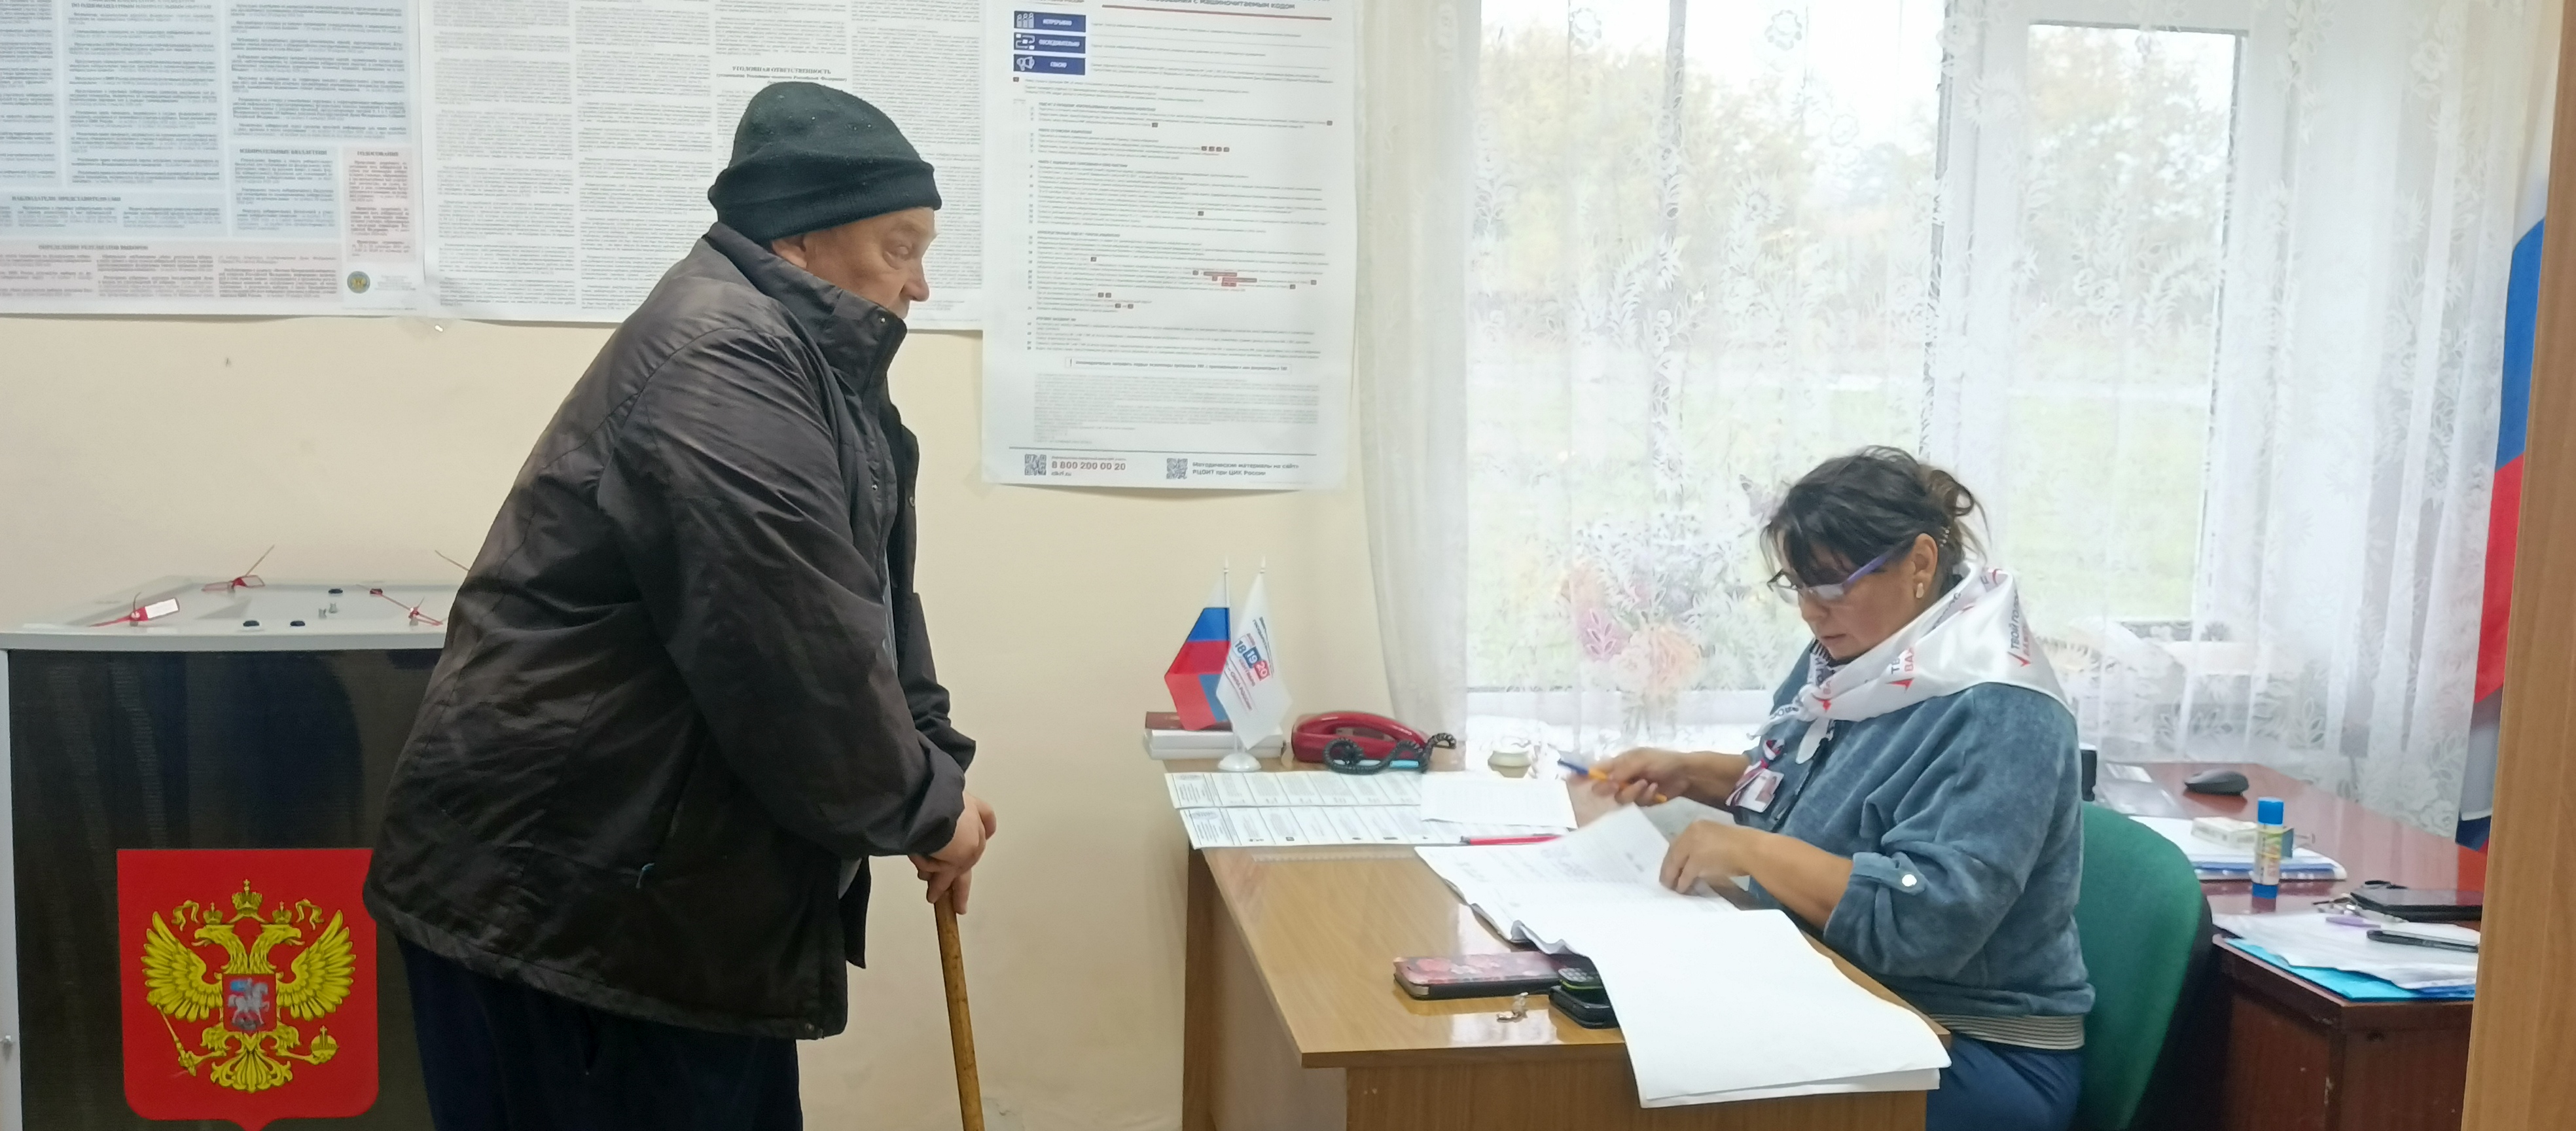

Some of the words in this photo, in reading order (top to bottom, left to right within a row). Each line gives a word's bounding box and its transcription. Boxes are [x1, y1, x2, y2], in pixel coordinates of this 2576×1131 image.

[2008, 622, 2020, 649] ТВОЙ
[1234, 639, 1247, 654] 18
[1247, 649, 1259, 664] 19
[1255, 660, 1268, 677] 20
